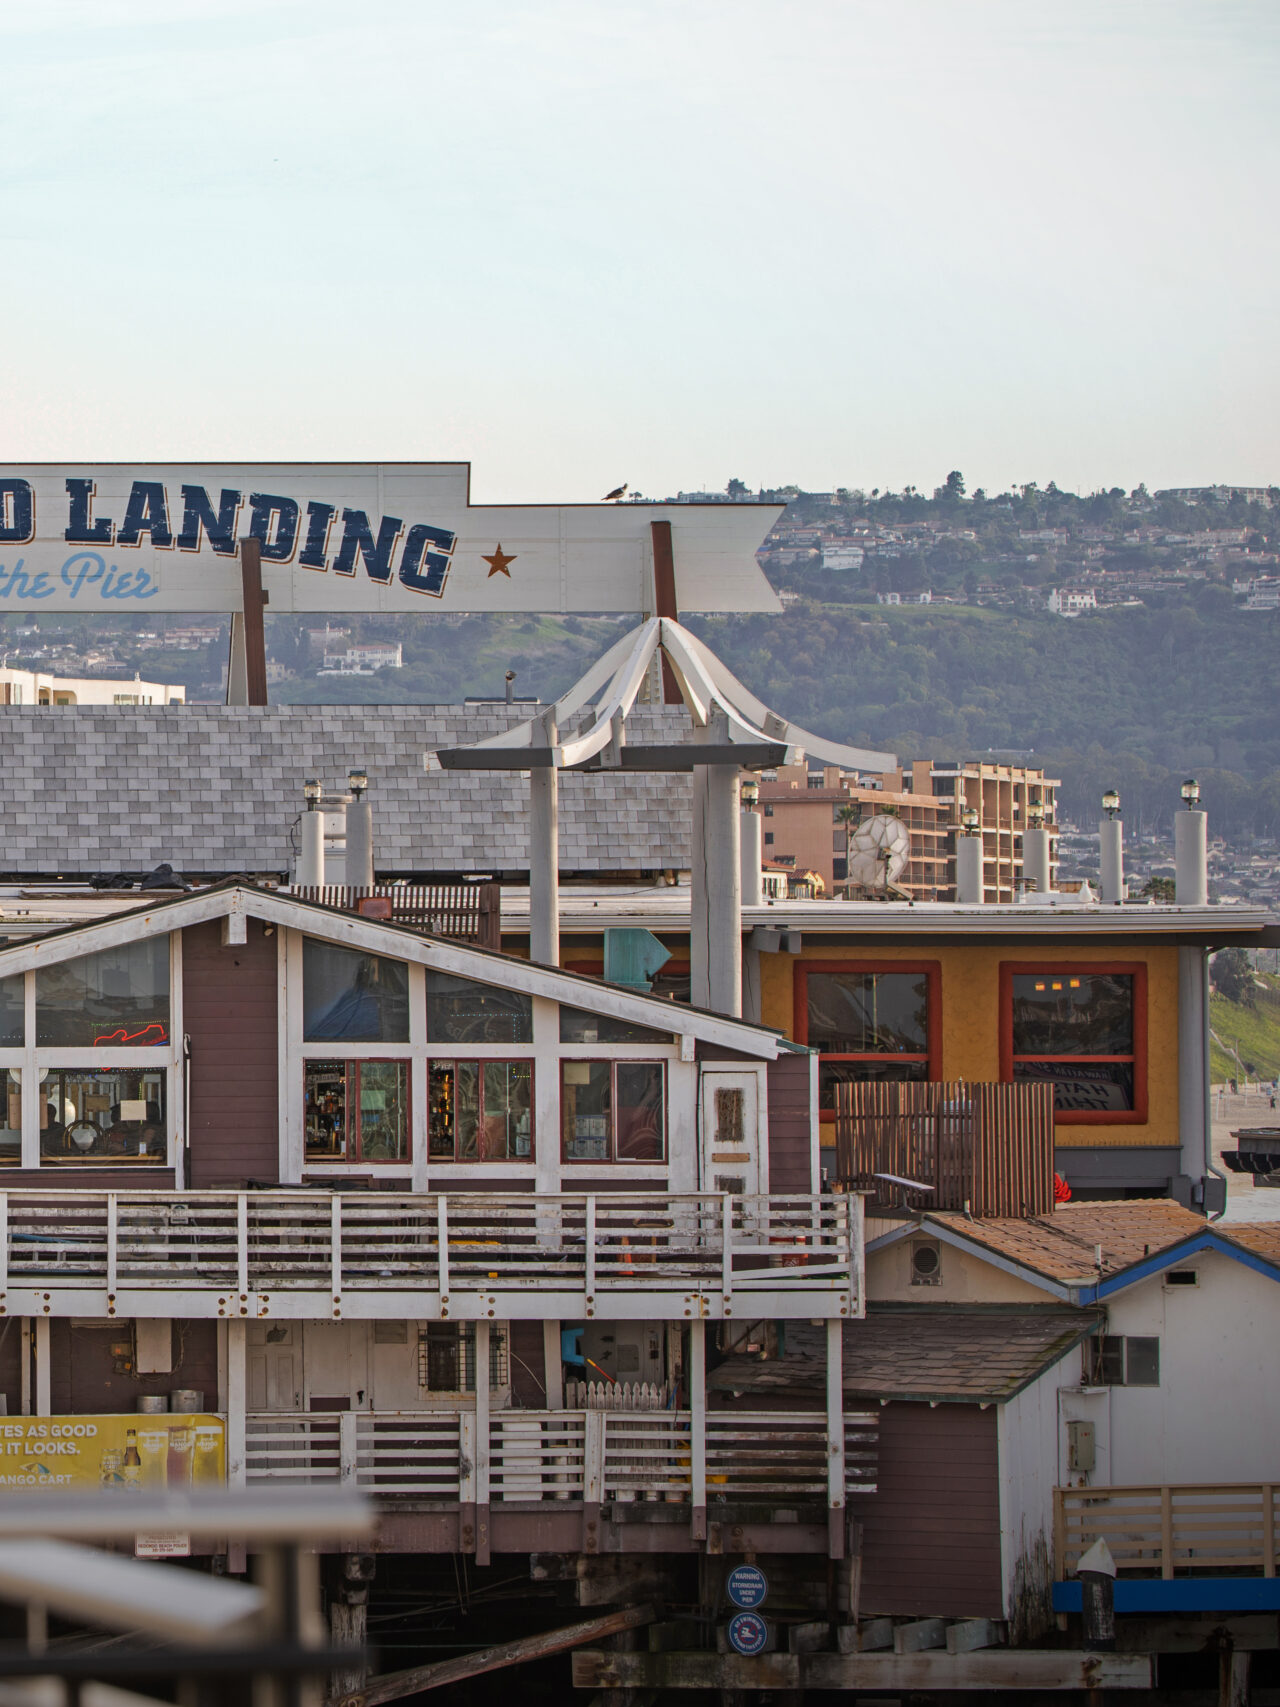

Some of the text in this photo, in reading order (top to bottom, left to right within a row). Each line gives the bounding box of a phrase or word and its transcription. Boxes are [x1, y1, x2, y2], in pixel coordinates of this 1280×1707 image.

[64, 478, 458, 599] LANDING
[61, 551, 159, 599] Pier
[26, 1424, 48, 1438] AS
[51, 1424, 98, 1437] GOOD
[6, 1441, 21, 1455] IT
[24, 1441, 81, 1455] LOOKS.
[38, 1474, 73, 1484] CART
